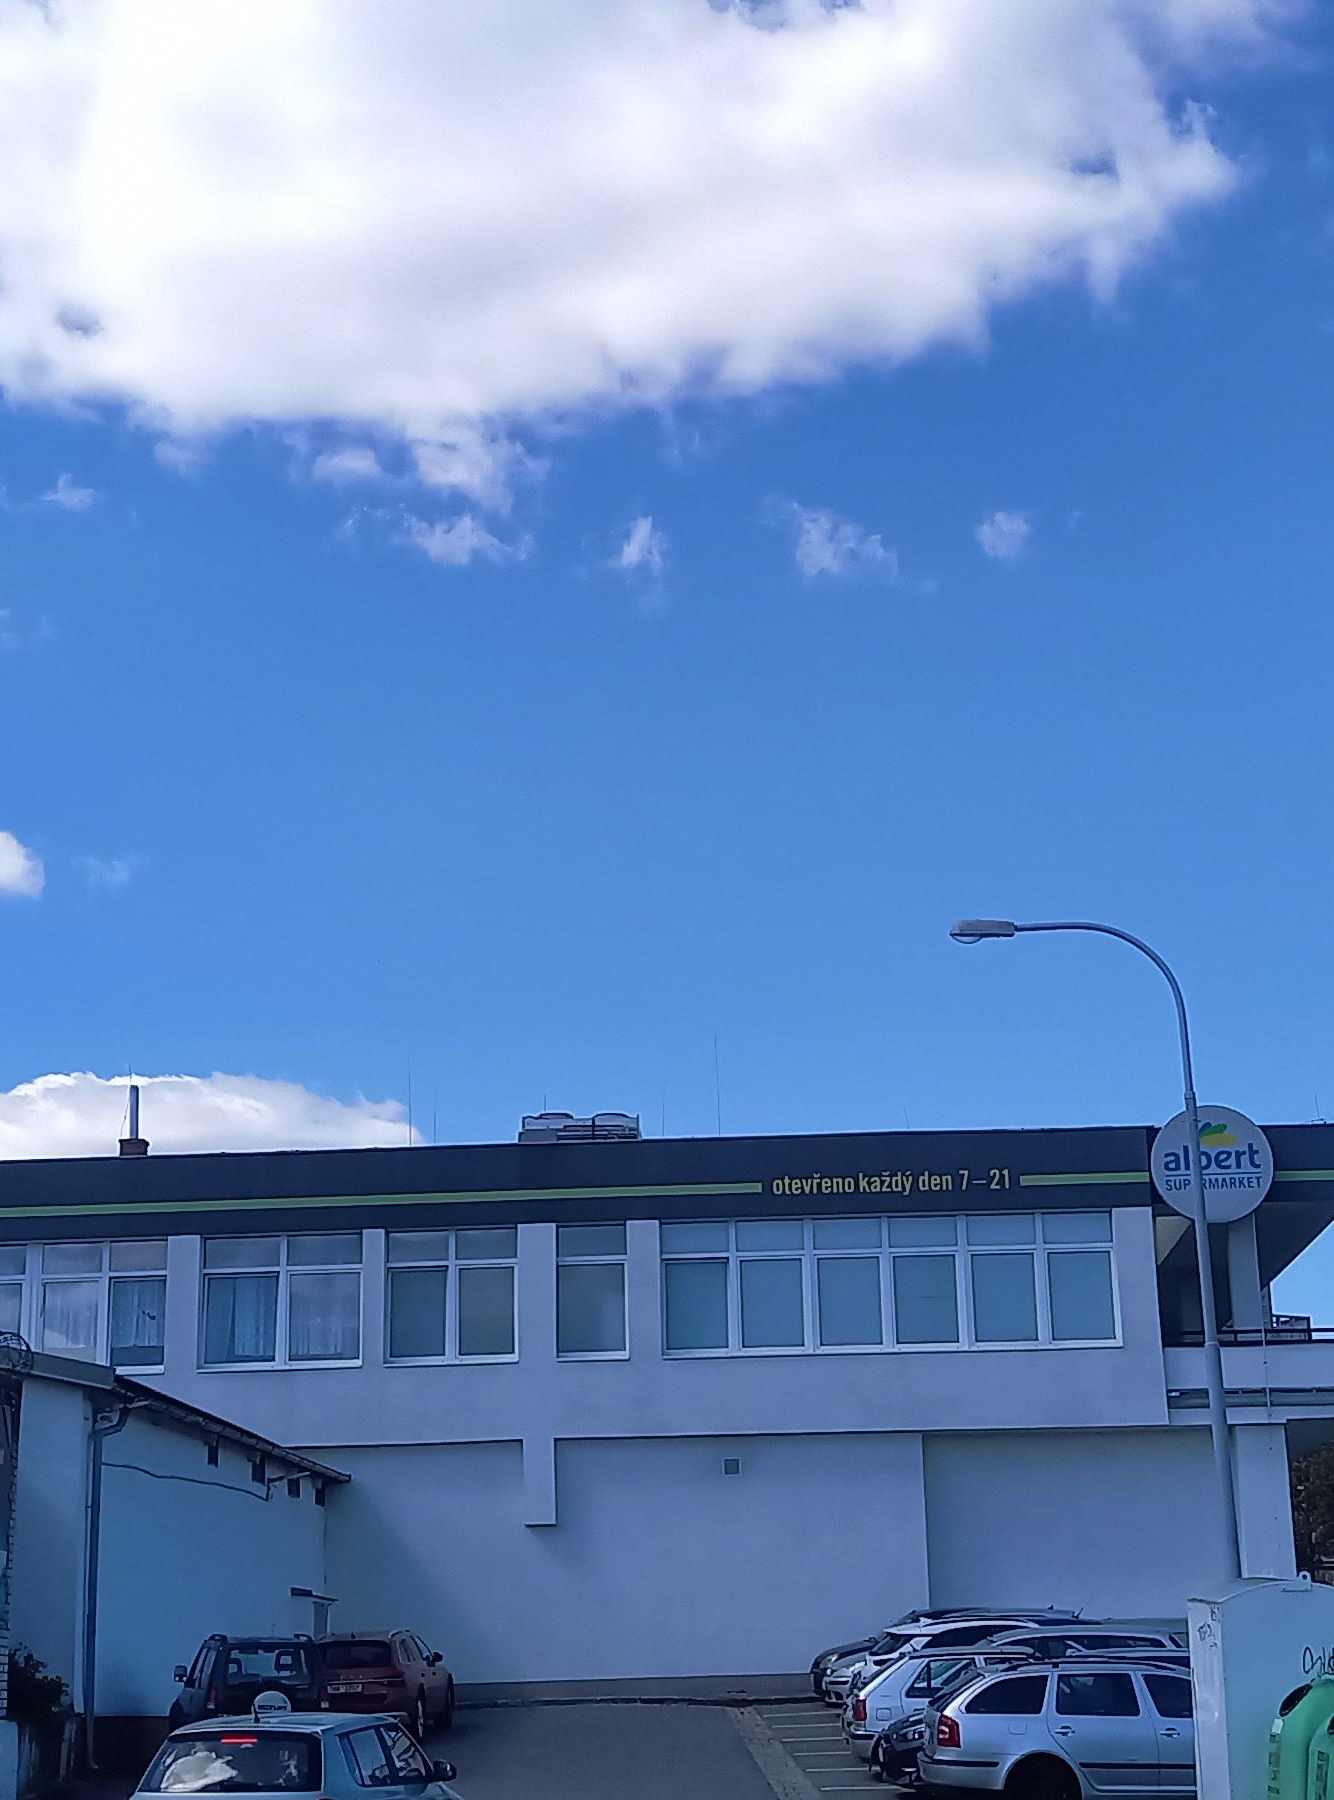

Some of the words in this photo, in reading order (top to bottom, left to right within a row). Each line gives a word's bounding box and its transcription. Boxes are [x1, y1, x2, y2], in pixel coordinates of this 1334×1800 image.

[771, 1173, 855, 1196] otevřeno
[858, 1170, 913, 1196] každý
[918, 1170, 953, 1192] den
[1164, 1175, 1263, 1192] SUPRMARKET
